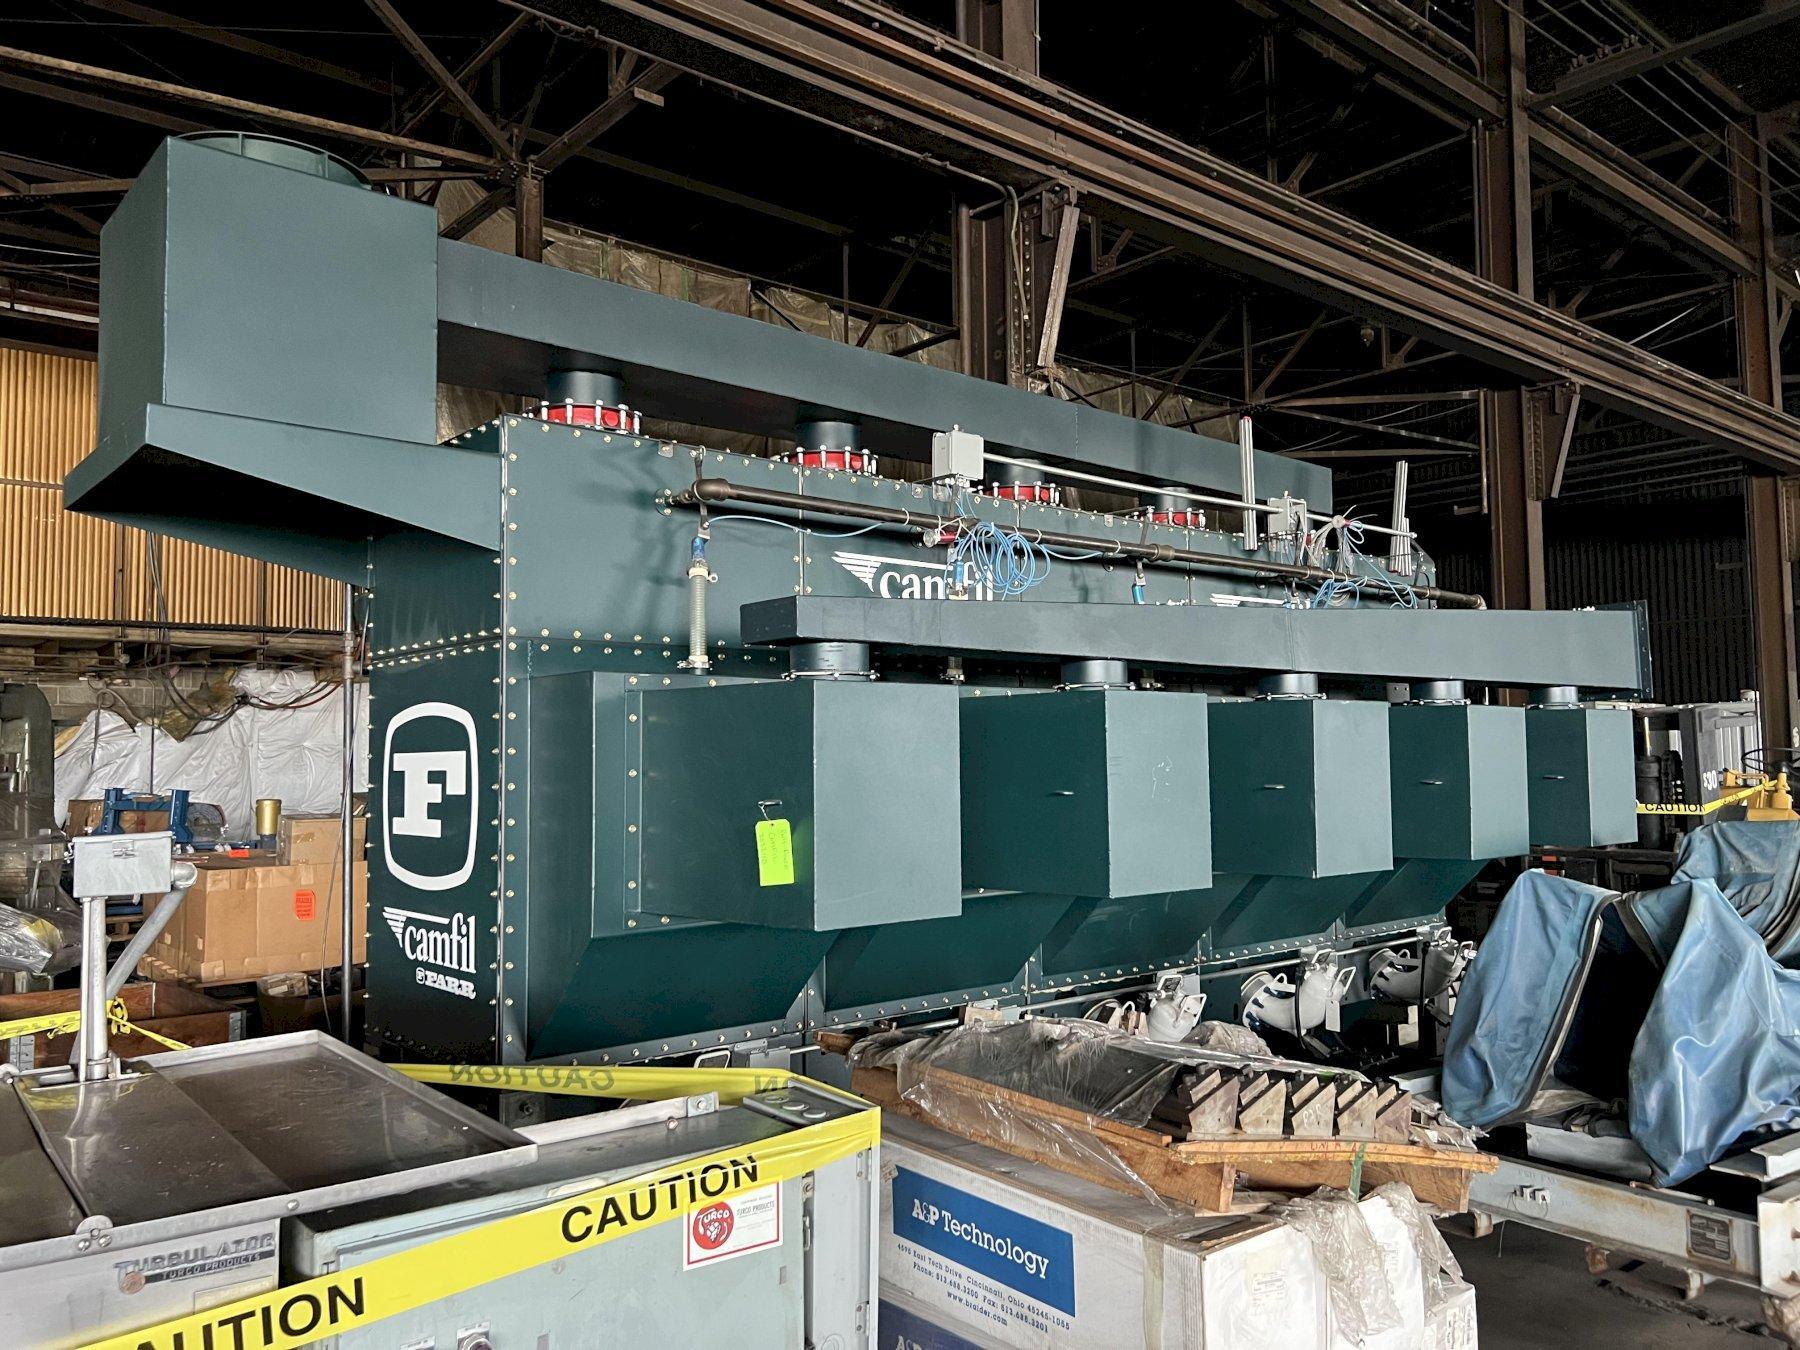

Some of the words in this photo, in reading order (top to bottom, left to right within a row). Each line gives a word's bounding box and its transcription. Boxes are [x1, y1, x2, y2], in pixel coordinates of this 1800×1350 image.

[393, 750, 466, 838] F
[404, 912, 477, 974] camfil
[425, 970, 476, 999] FARR
[561, 1155, 758, 1243] CAUTION
[698, 1207, 730, 1236] TURCO
[204, 1252, 262, 1273] PRODUCTS
[911, 1198, 940, 1226] A&P
[942, 1210, 1049, 1279] Technology
[913, 1261, 934, 1278] Phone:
[983, 1295, 998, 1309] Fax:
[928, 1257, 943, 1270] Tech
[945, 1265, 962, 1280] Drive
[1007, 1295, 1025, 1309] Ohio
[947, 1291, 1008, 1327] www.braider.com
